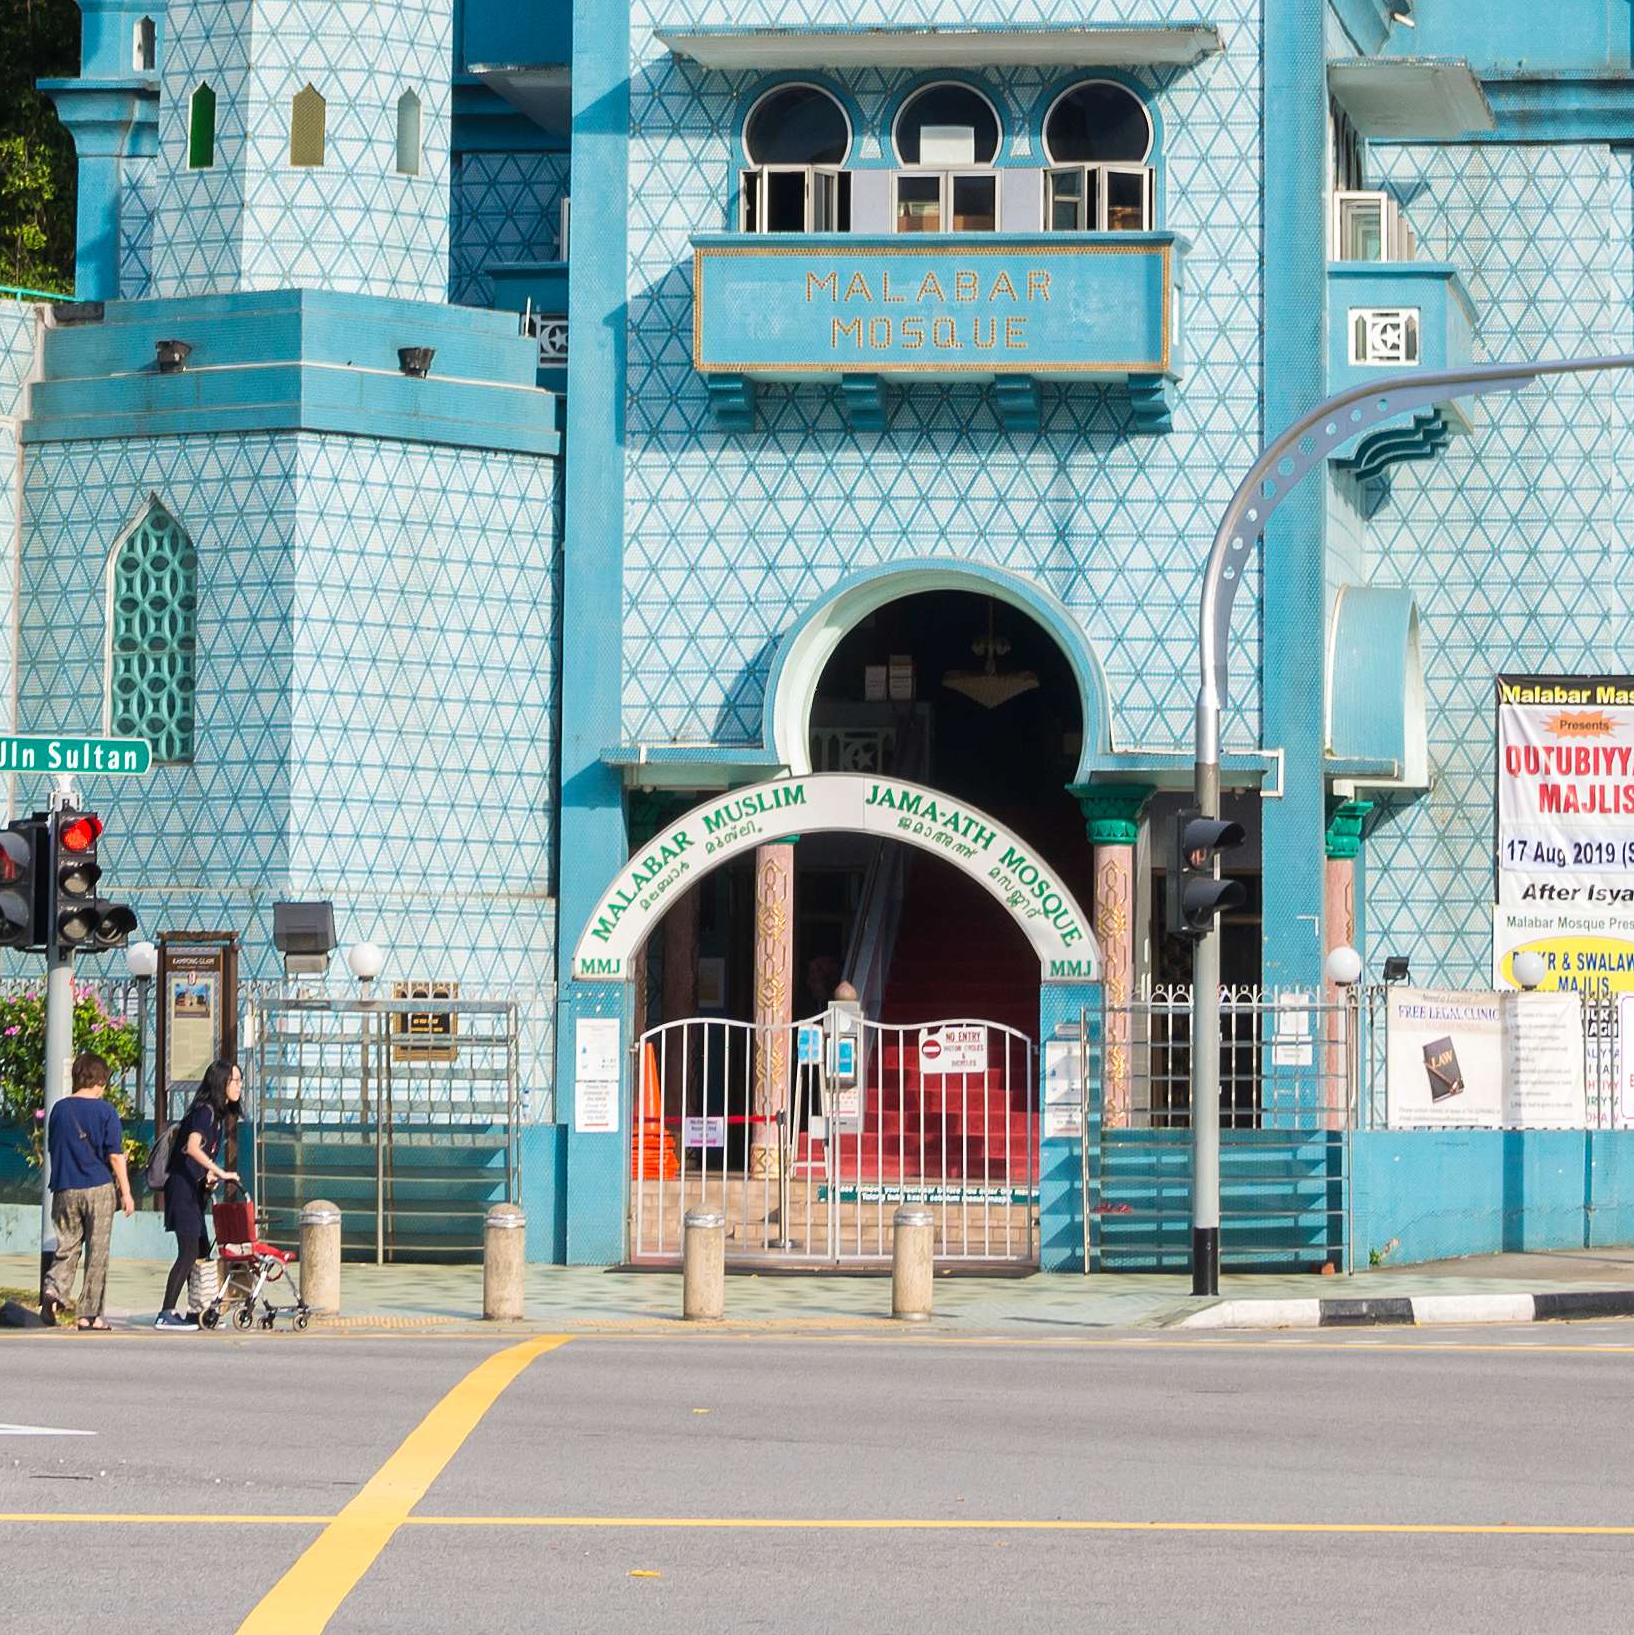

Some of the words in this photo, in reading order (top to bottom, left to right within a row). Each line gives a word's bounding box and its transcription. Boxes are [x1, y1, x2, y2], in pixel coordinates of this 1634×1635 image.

[806, 270, 1051, 302] MALABAR
[832, 317, 1029, 349] MOSQUE
[1502, 686, 1591, 704] Malabar
[1560, 720, 1609, 731] Presents
[48, 741, 137, 770] Sultan
[1508, 840, 1527, 861] 17
[1533, 841, 1566, 867] Aug
[1573, 842, 1615, 864] 2019
[591, 830, 695, 942] MALABAR
[701, 784, 806, 834] MUSLIM
[866, 785, 997, 851] JAMA-ATH
[998, 847, 1083, 948] MOSQUE
[1522, 883, 1581, 901] After
[1507, 917, 1554, 929] Malabar
[1558, 917, 1605, 931] Mosque
[581, 958, 620, 974] MMJ
[1050, 960, 1092, 977] MMJ
[1398, 1005, 1426, 1018] FREE
[1429, 1005, 1464, 1020] LEGAL
[945, 1031, 955, 1041] NO
[958, 1031, 980, 1042] ENTRY
[1431, 1049, 1454, 1068] LAW
